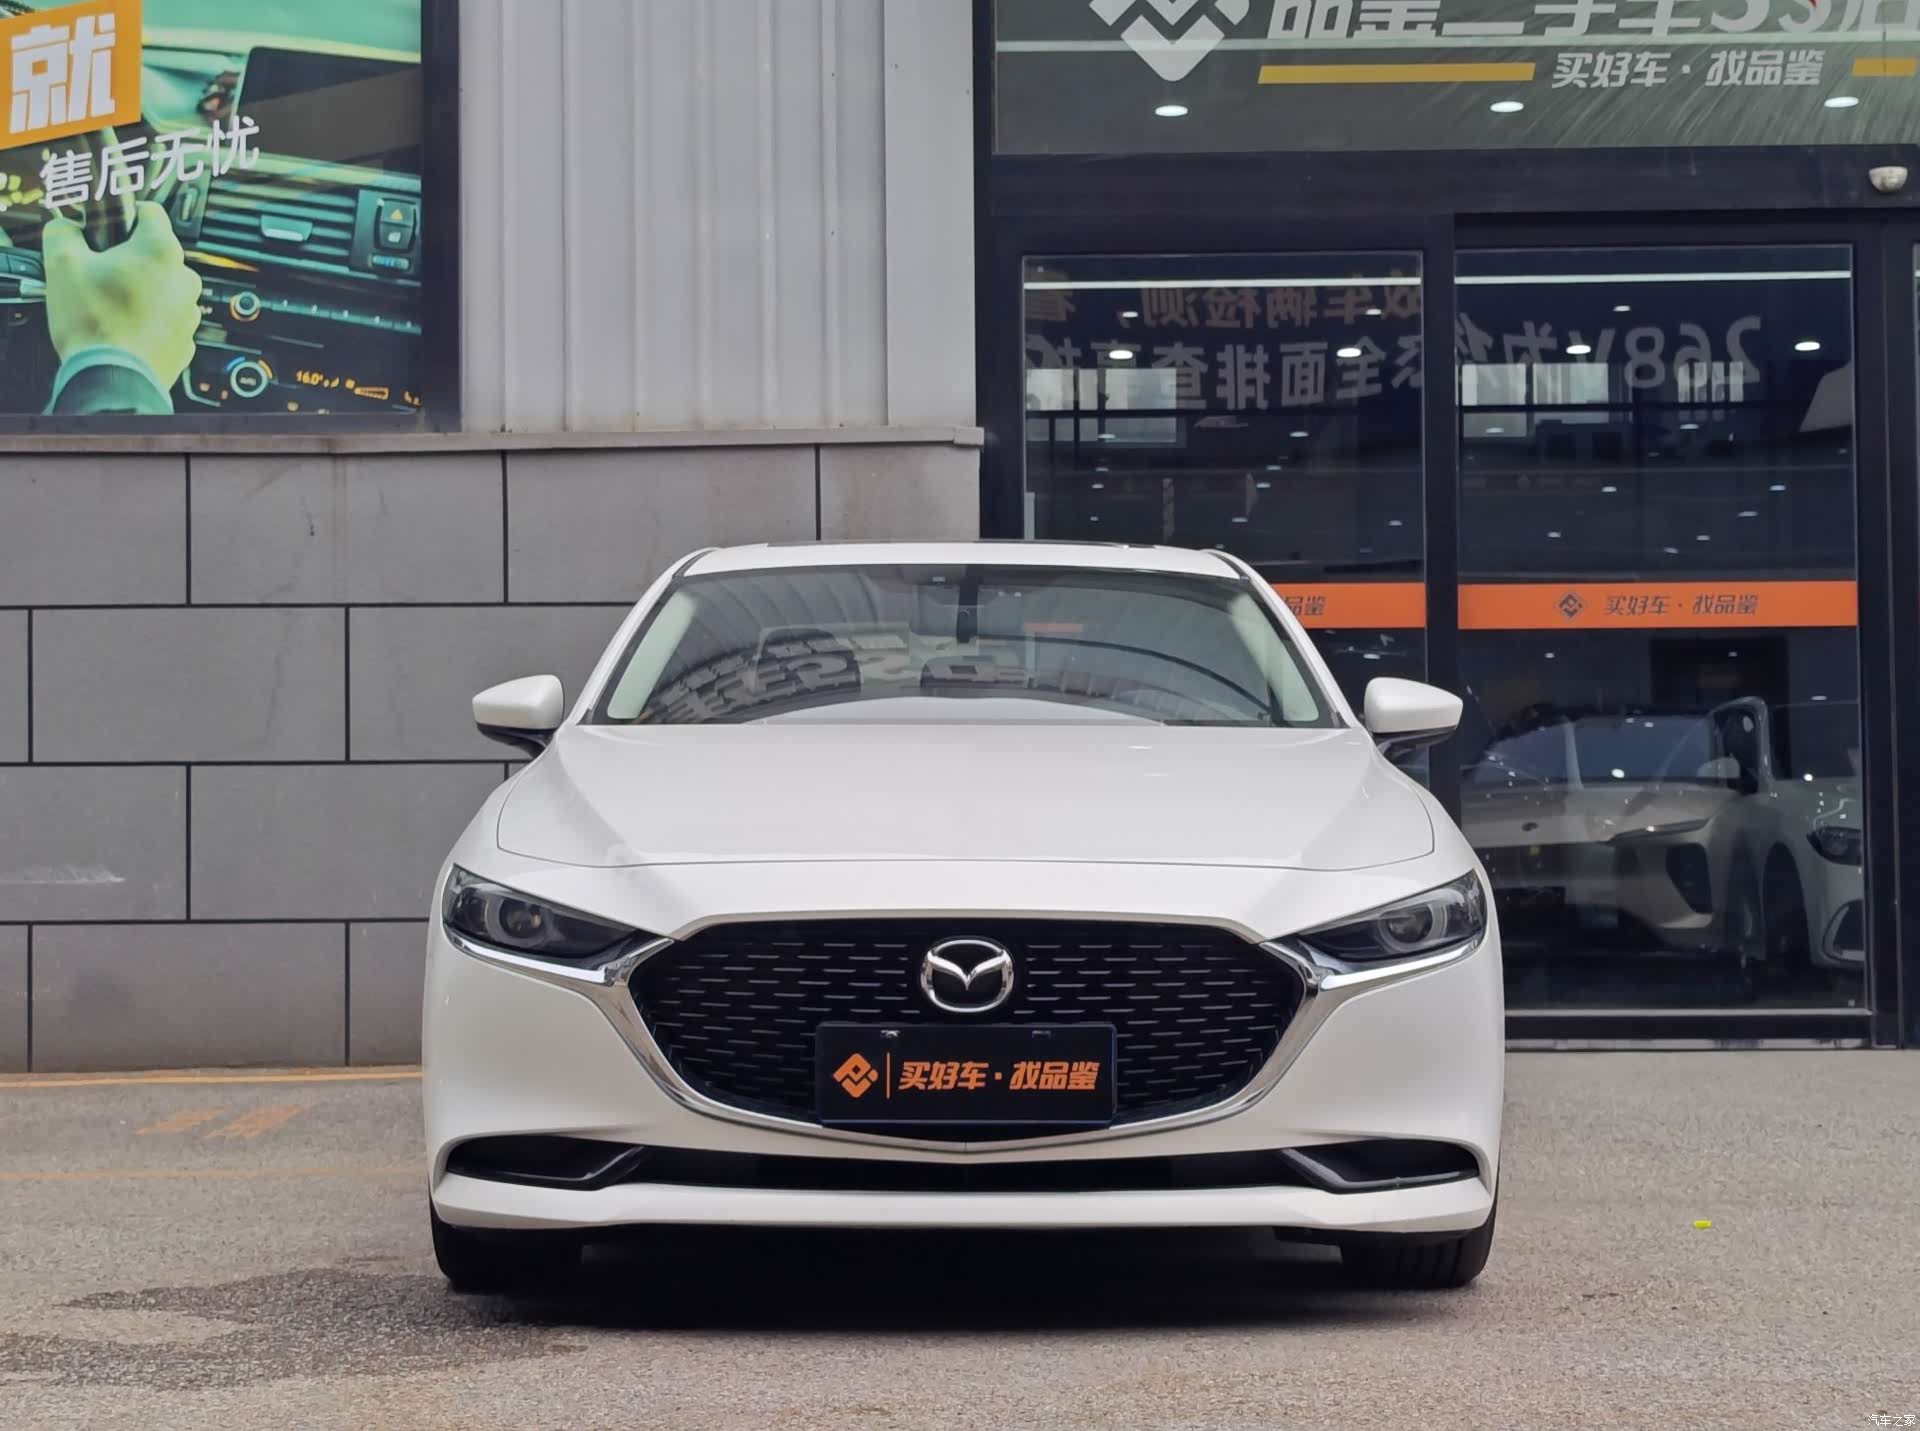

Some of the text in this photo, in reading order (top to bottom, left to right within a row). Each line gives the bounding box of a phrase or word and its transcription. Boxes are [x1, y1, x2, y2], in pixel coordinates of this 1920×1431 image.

[8, 13, 116, 134] 就
[39, 114, 260, 209] 售后无忧
